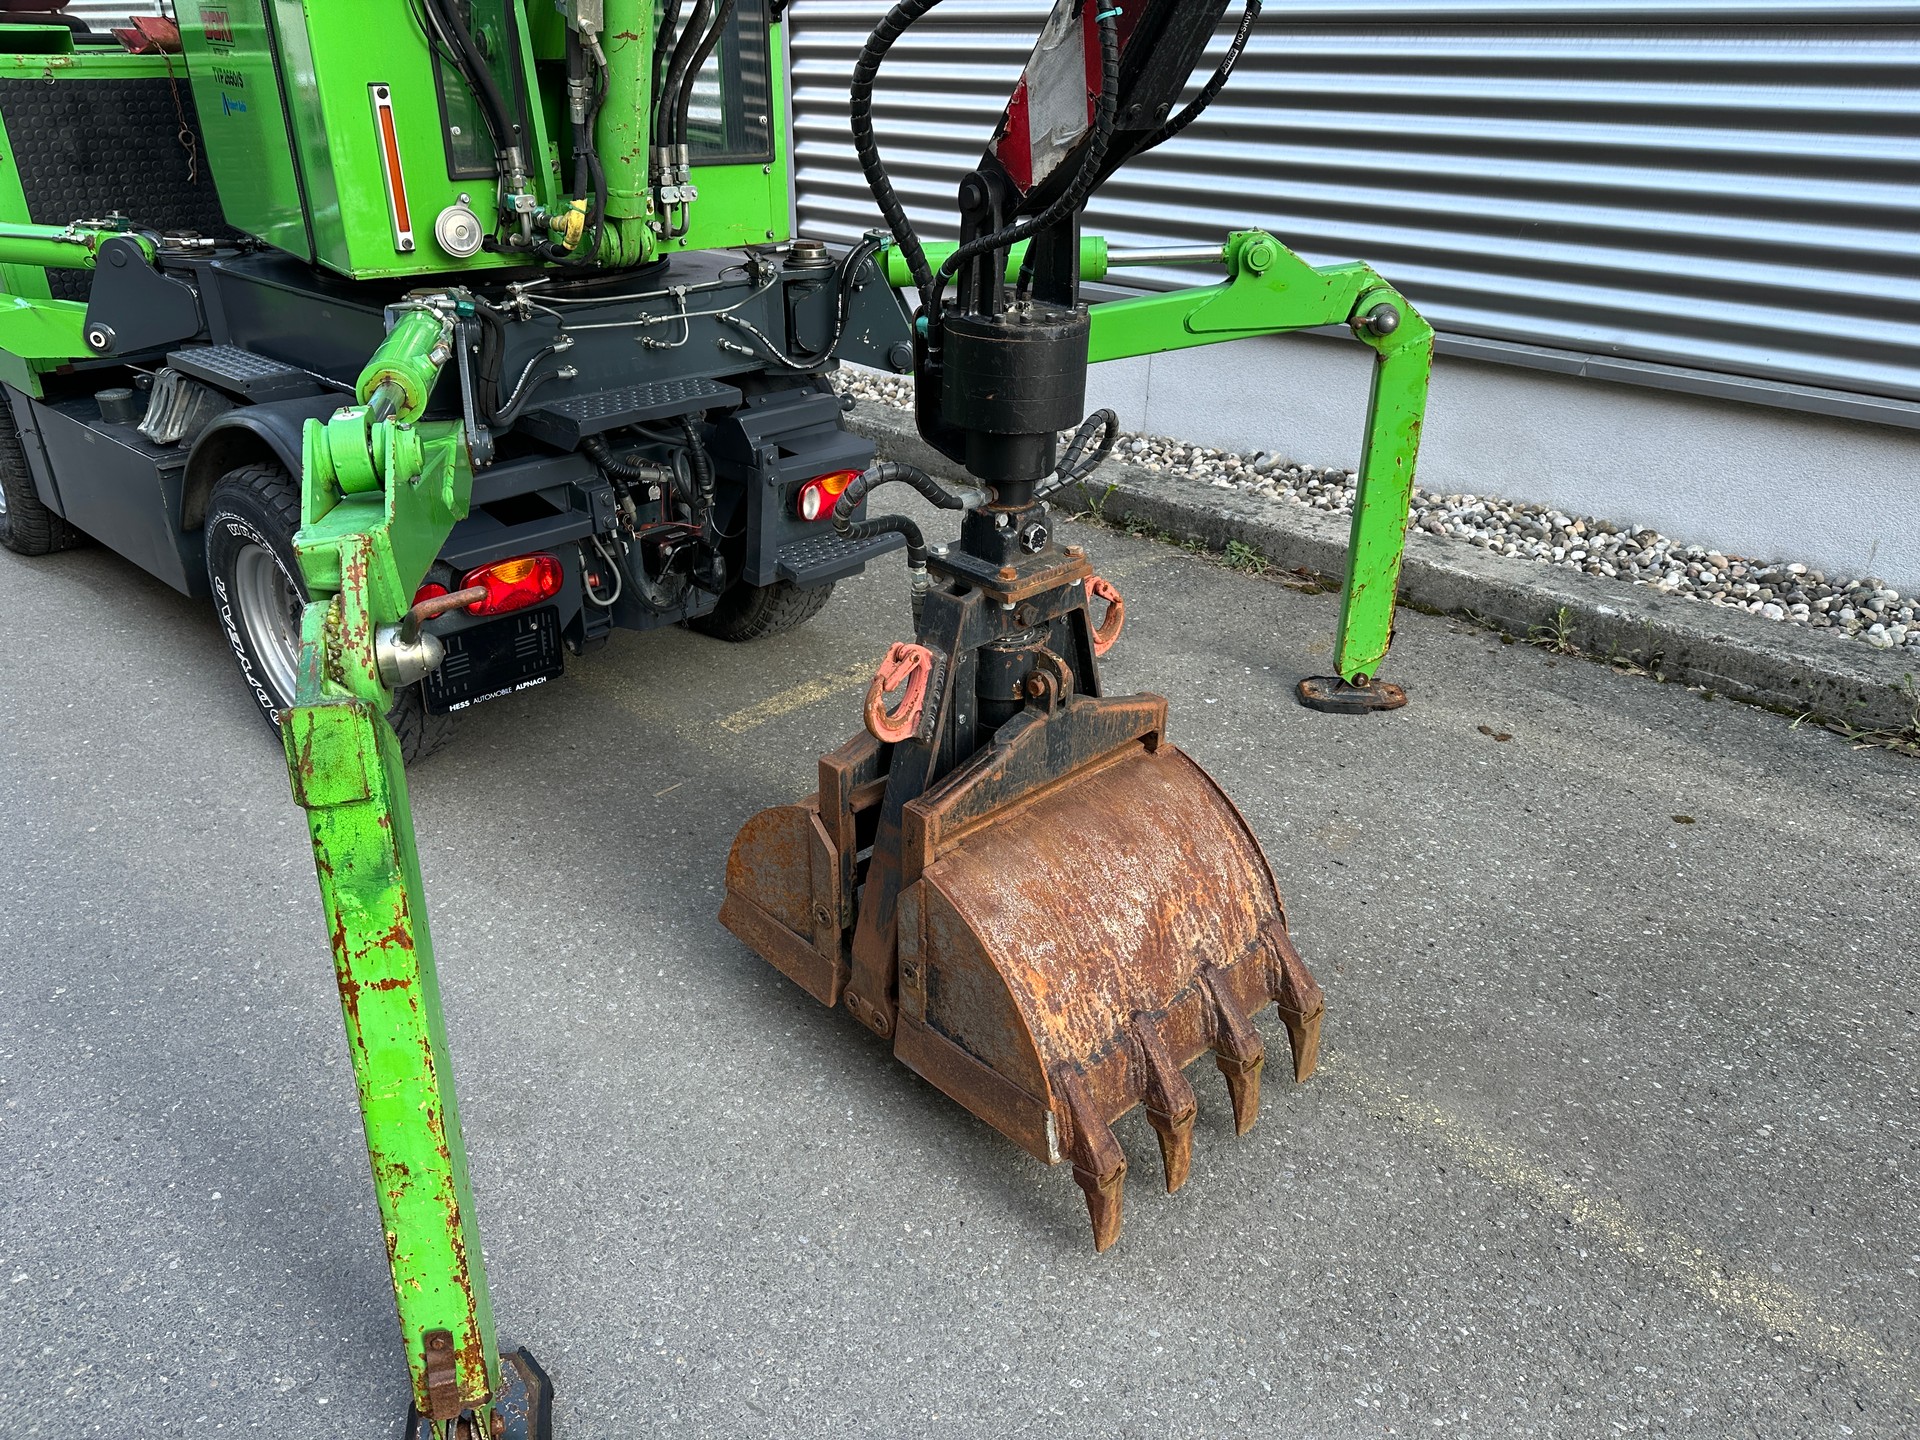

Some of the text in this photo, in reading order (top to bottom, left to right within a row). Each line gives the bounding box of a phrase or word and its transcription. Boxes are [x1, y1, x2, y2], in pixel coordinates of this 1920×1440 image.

[449, 676, 547, 712] HESS AUTOMOBILE ALPNACH
